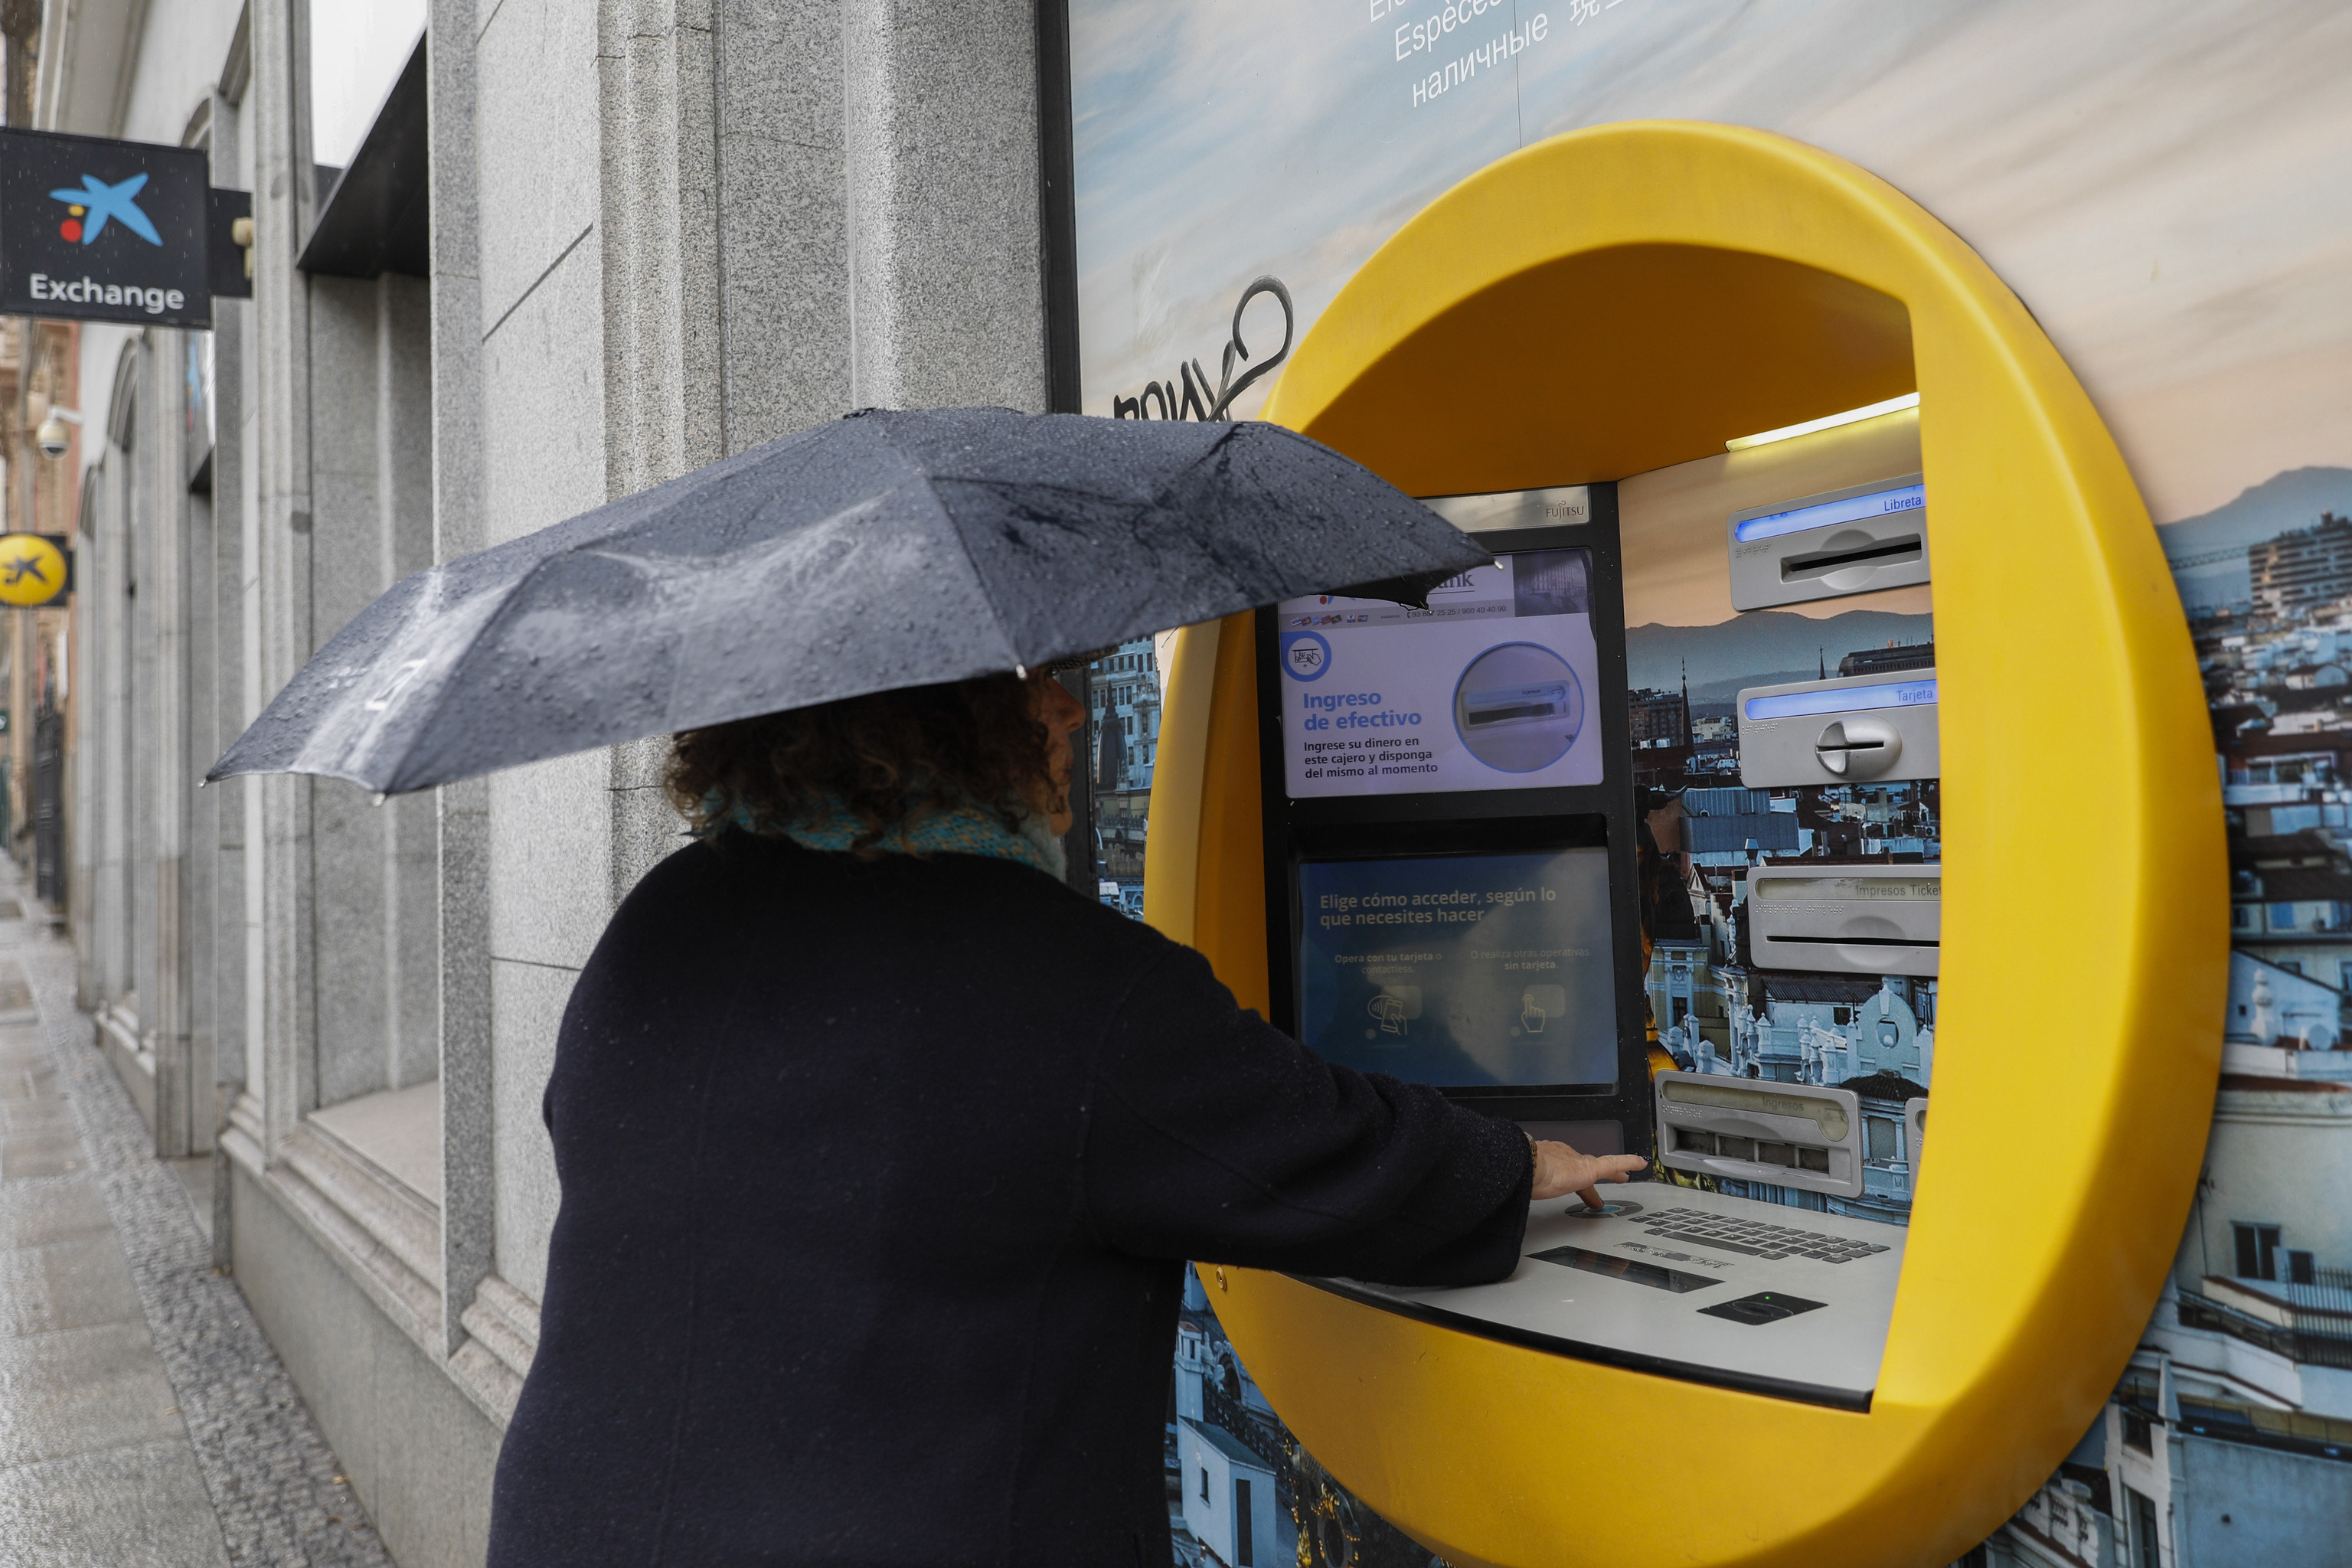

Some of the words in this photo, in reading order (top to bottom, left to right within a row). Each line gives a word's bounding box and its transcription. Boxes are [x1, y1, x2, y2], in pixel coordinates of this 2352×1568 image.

[1395, 0, 1501, 62] Espèce
[1413, 13, 1548, 108] наличные
[29, 273, 185, 314] Exchange
[1546, 502, 1584, 520] FUJITSU
[1883, 495, 1922, 511] Libreta
[1303, 692, 1382, 711] Ingreso
[1896, 688, 1933, 702] Tarjeta
[1304, 714, 1330, 731] de
[1336, 710, 1422, 729] efectivo
[1304, 741, 1345, 753] Ingrese
[1348, 740, 1361, 750] su
[1364, 738, 1402, 748] dinero
[1405, 737, 1419, 746] en
[1305, 755, 1328, 765] este
[1331, 753, 1365, 765] cajero
[1369, 754, 1376, 764] y
[1379, 751, 1432, 763] disponga
[1305, 768, 1323, 779] del
[1327, 767, 1364, 777] mismo
[1367, 765, 1378, 776] al
[1382, 763, 1438, 775] momento
[1856, 884, 1906, 897] Impresos
[1320, 895, 1358, 912] Elige
[1362, 893, 1407, 907] cómo
[1412, 890, 1481, 906] acceder,
[1485, 888, 1536, 906] según
[1541, 887, 1557, 901] lo
[1320, 913, 1351, 930] que
[1356, 910, 1432, 925] necesites
[1437, 908, 1485, 922] hacer
[1334, 954, 1364, 965] Opera
[1400, 952, 1433, 962] tarjeta
[1481, 949, 1511, 959] realiza
[1540, 948, 1590, 959] operativas
[1504, 961, 1518, 970] sin
[1762, 1097, 1805, 1112] Ingresos
